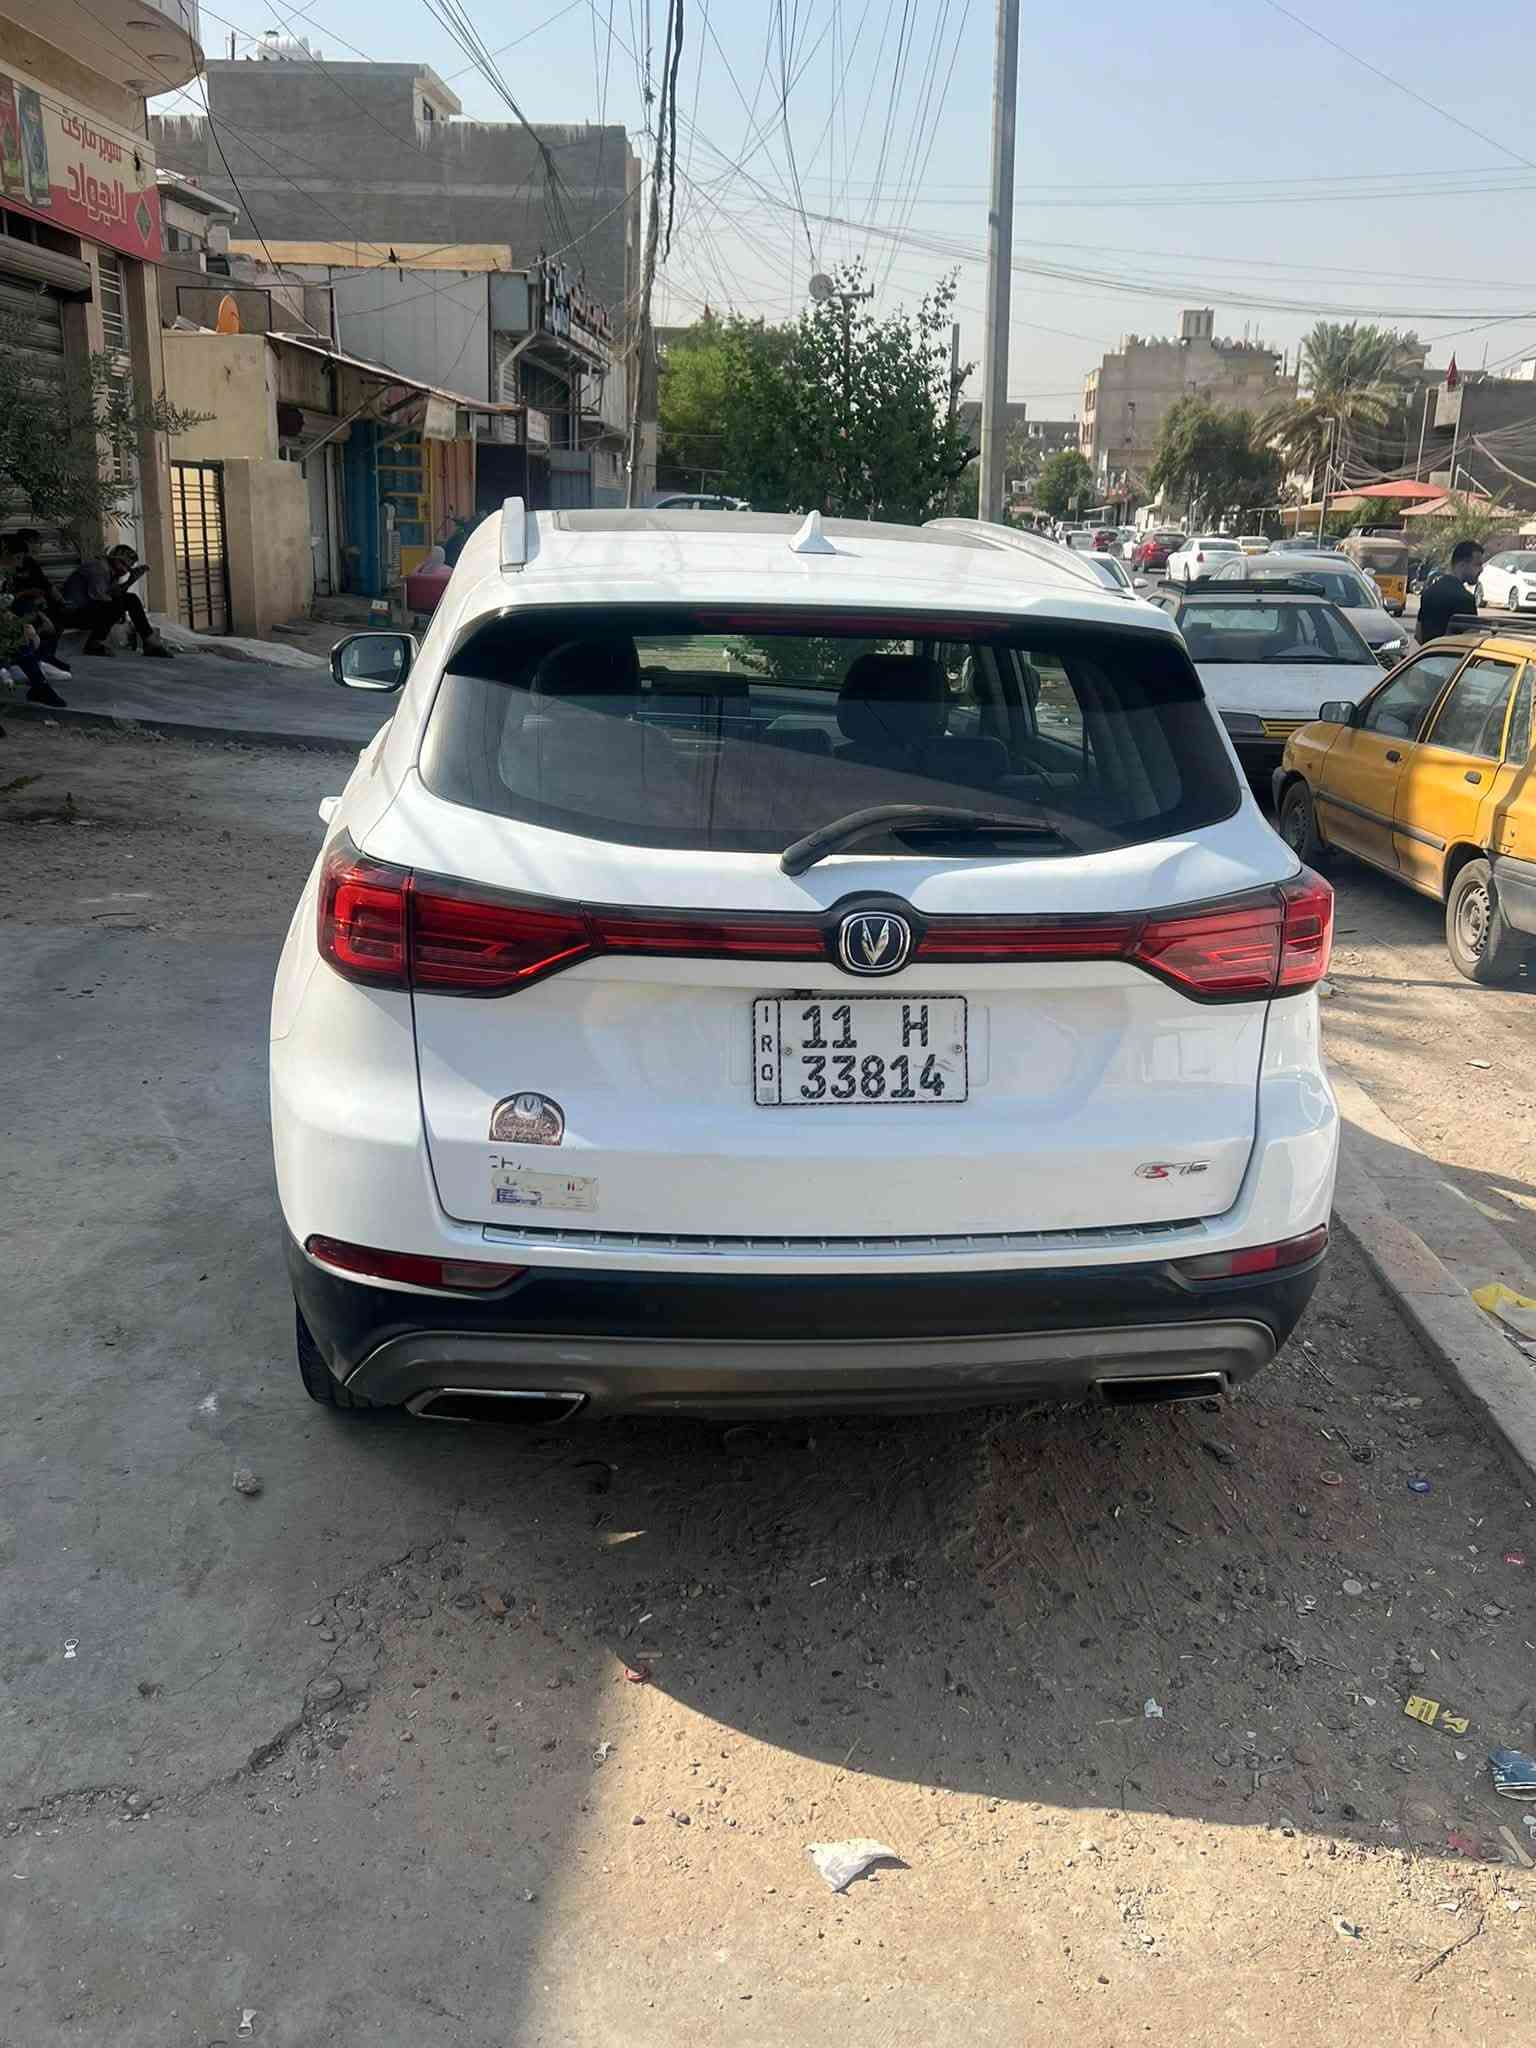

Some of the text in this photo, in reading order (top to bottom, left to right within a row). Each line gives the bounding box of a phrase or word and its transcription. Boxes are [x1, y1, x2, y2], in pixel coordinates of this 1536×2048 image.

[61, 107, 122, 163] سوبر ماركت
[65, 162, 127, 227] الجواد
[760, 1005, 775, 1082] IRQ
[801, 1004, 929, 1049] 11 H
[799, 1053, 945, 1099] 33814
